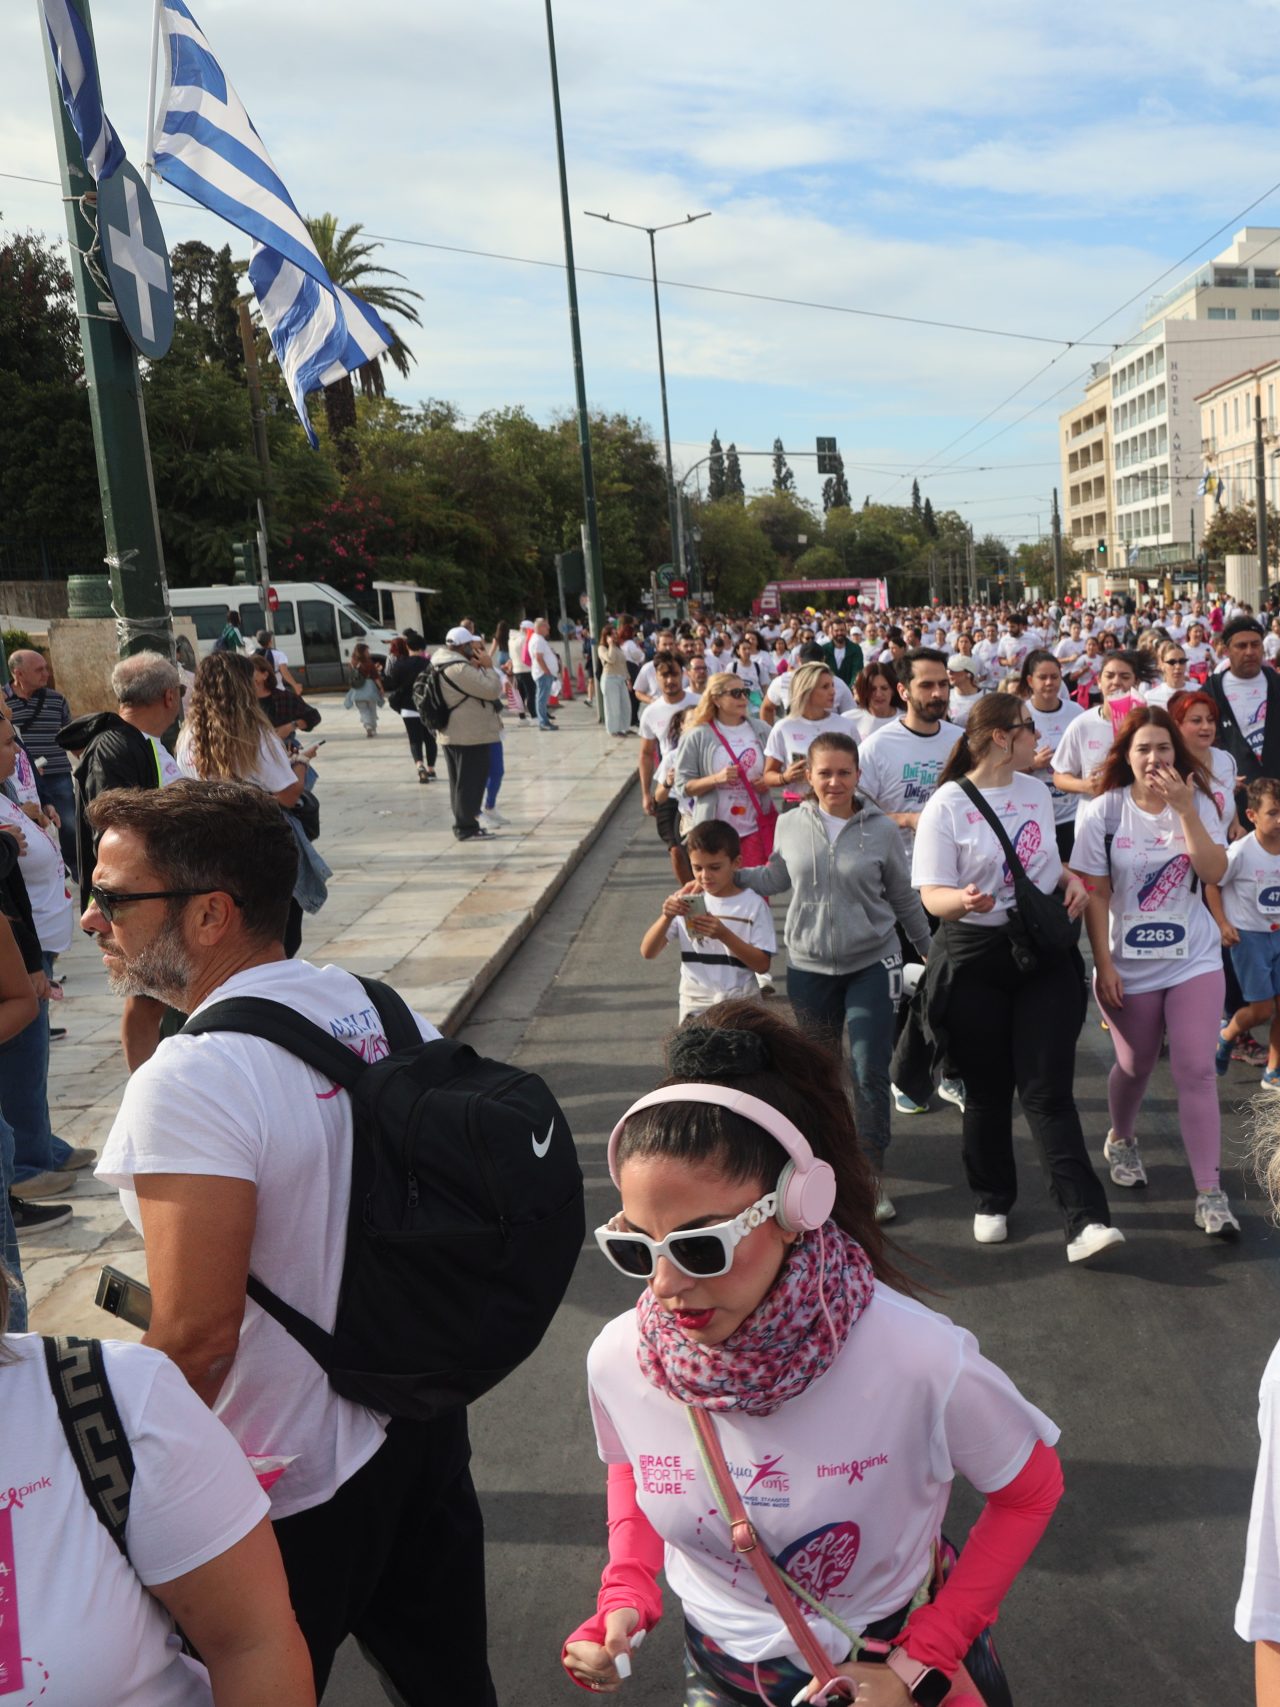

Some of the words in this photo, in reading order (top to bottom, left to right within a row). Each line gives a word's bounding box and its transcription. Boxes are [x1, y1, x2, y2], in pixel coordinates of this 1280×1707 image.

[1171, 361, 1179, 417] HOTEL
[1173, 432, 1182, 497] AMALIA
[1136, 929, 1175, 942] 2263
[647, 1455, 681, 1468] RACE
[817, 1462, 850, 1477] think
[860, 1453, 889, 1473] pink
[648, 1468, 671, 1480] FOR
[672, 1469, 696, 1481] THE
[18, 1476, 52, 1500] pink
[648, 1482, 687, 1495] CURE.
